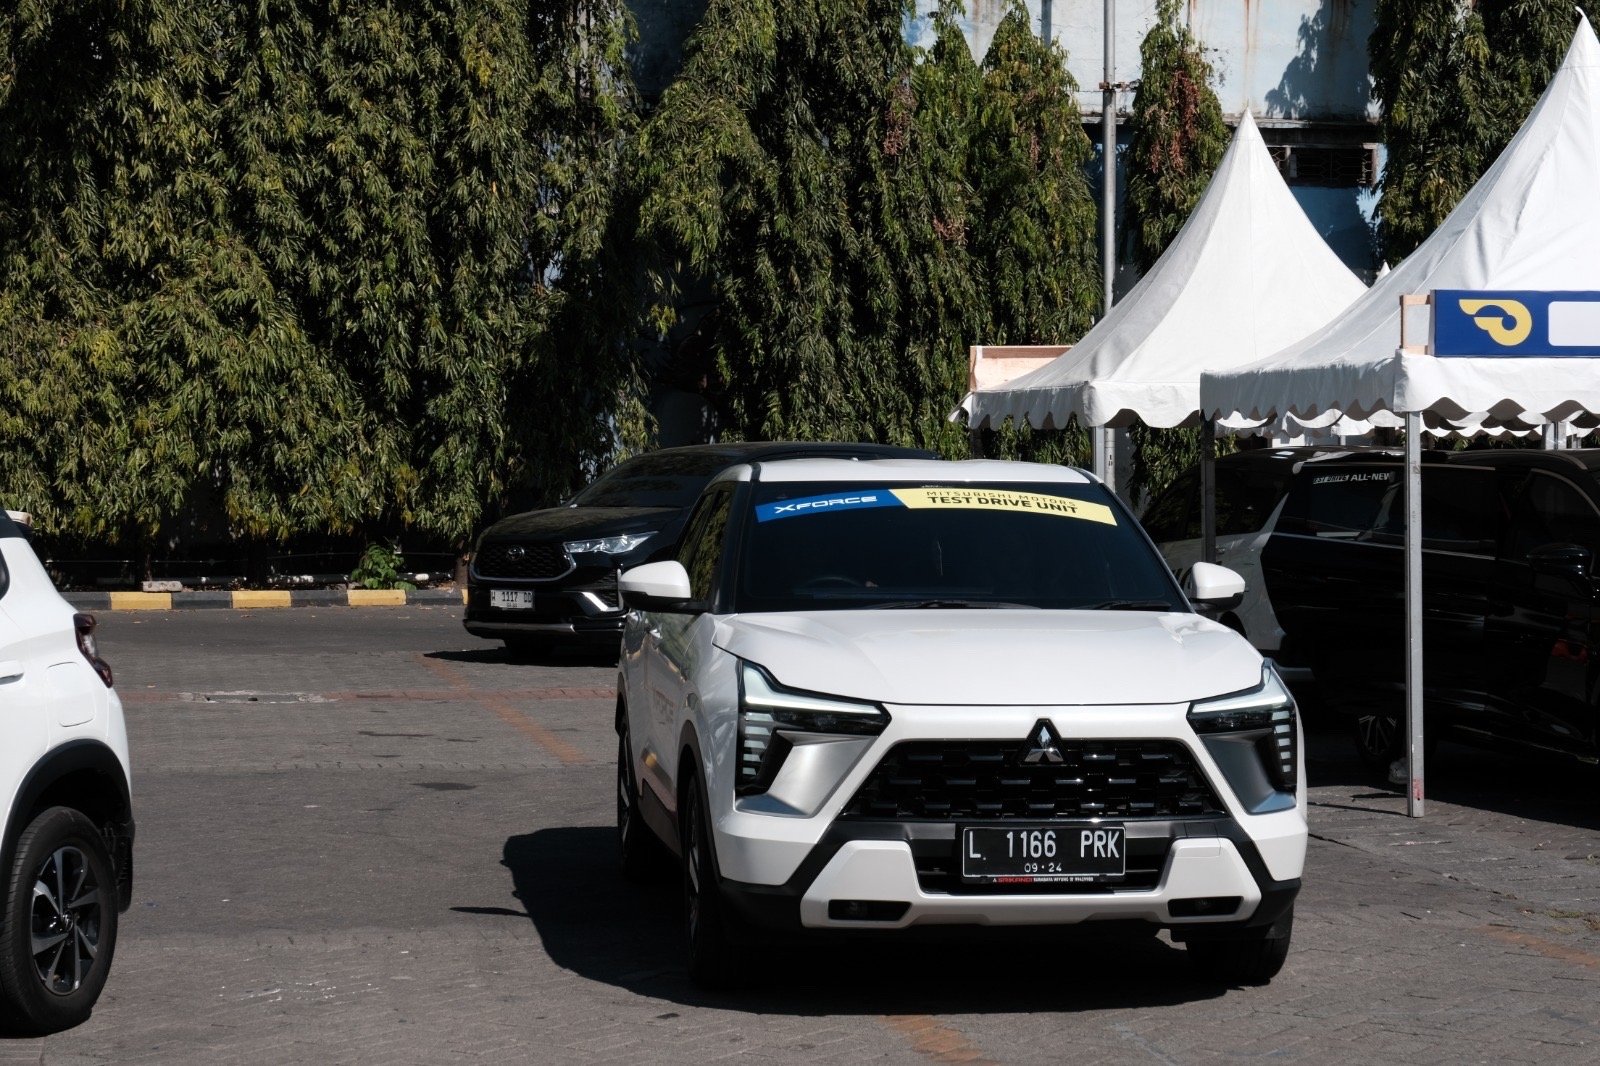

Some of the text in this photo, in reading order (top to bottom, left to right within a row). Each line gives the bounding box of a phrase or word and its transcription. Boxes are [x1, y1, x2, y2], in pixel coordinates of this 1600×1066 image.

[774, 496, 878, 514] XFORCE
[926, 491, 1076, 507] MITSUBISHI MOTORS
[927, 496, 1078, 514] TEST DRIVE UNIT
[502, 592, 518, 602] 1117
[1006, 830, 1057, 858] 1166
[1080, 830, 1120, 858] PRK
